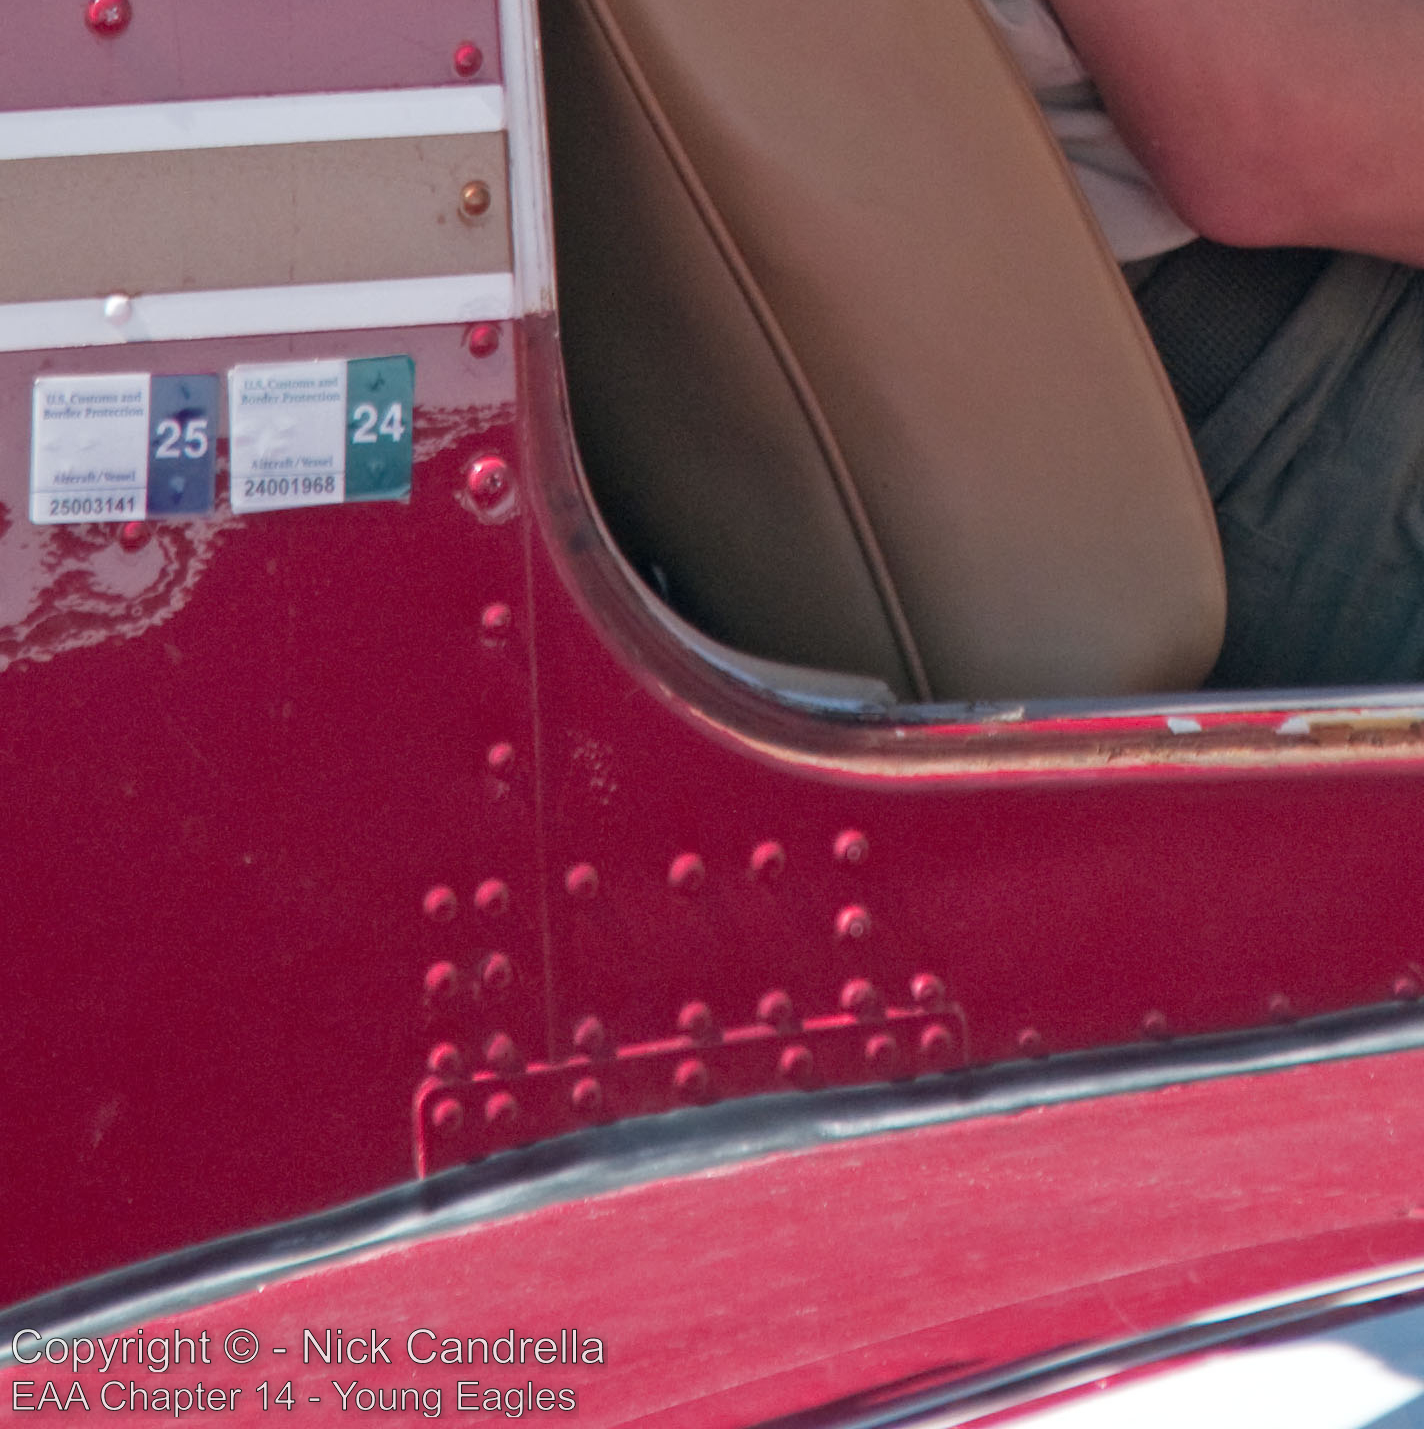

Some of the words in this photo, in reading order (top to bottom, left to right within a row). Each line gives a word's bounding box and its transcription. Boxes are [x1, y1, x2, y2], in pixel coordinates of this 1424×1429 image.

[268, 378, 315, 391] Customs
[318, 377, 339, 389] and
[70, 393, 118, 406] Customs
[121, 391, 142, 404] and
[241, 393, 280, 406] Border
[282, 391, 341, 405] Protection
[43, 407, 82, 421] Border
[84, 405, 144, 420] Protection
[352, 402, 406, 445] 24
[155, 419, 209, 460] 25
[244, 476, 336, 498] 24001968
[50, 496, 135, 517] 25003141
